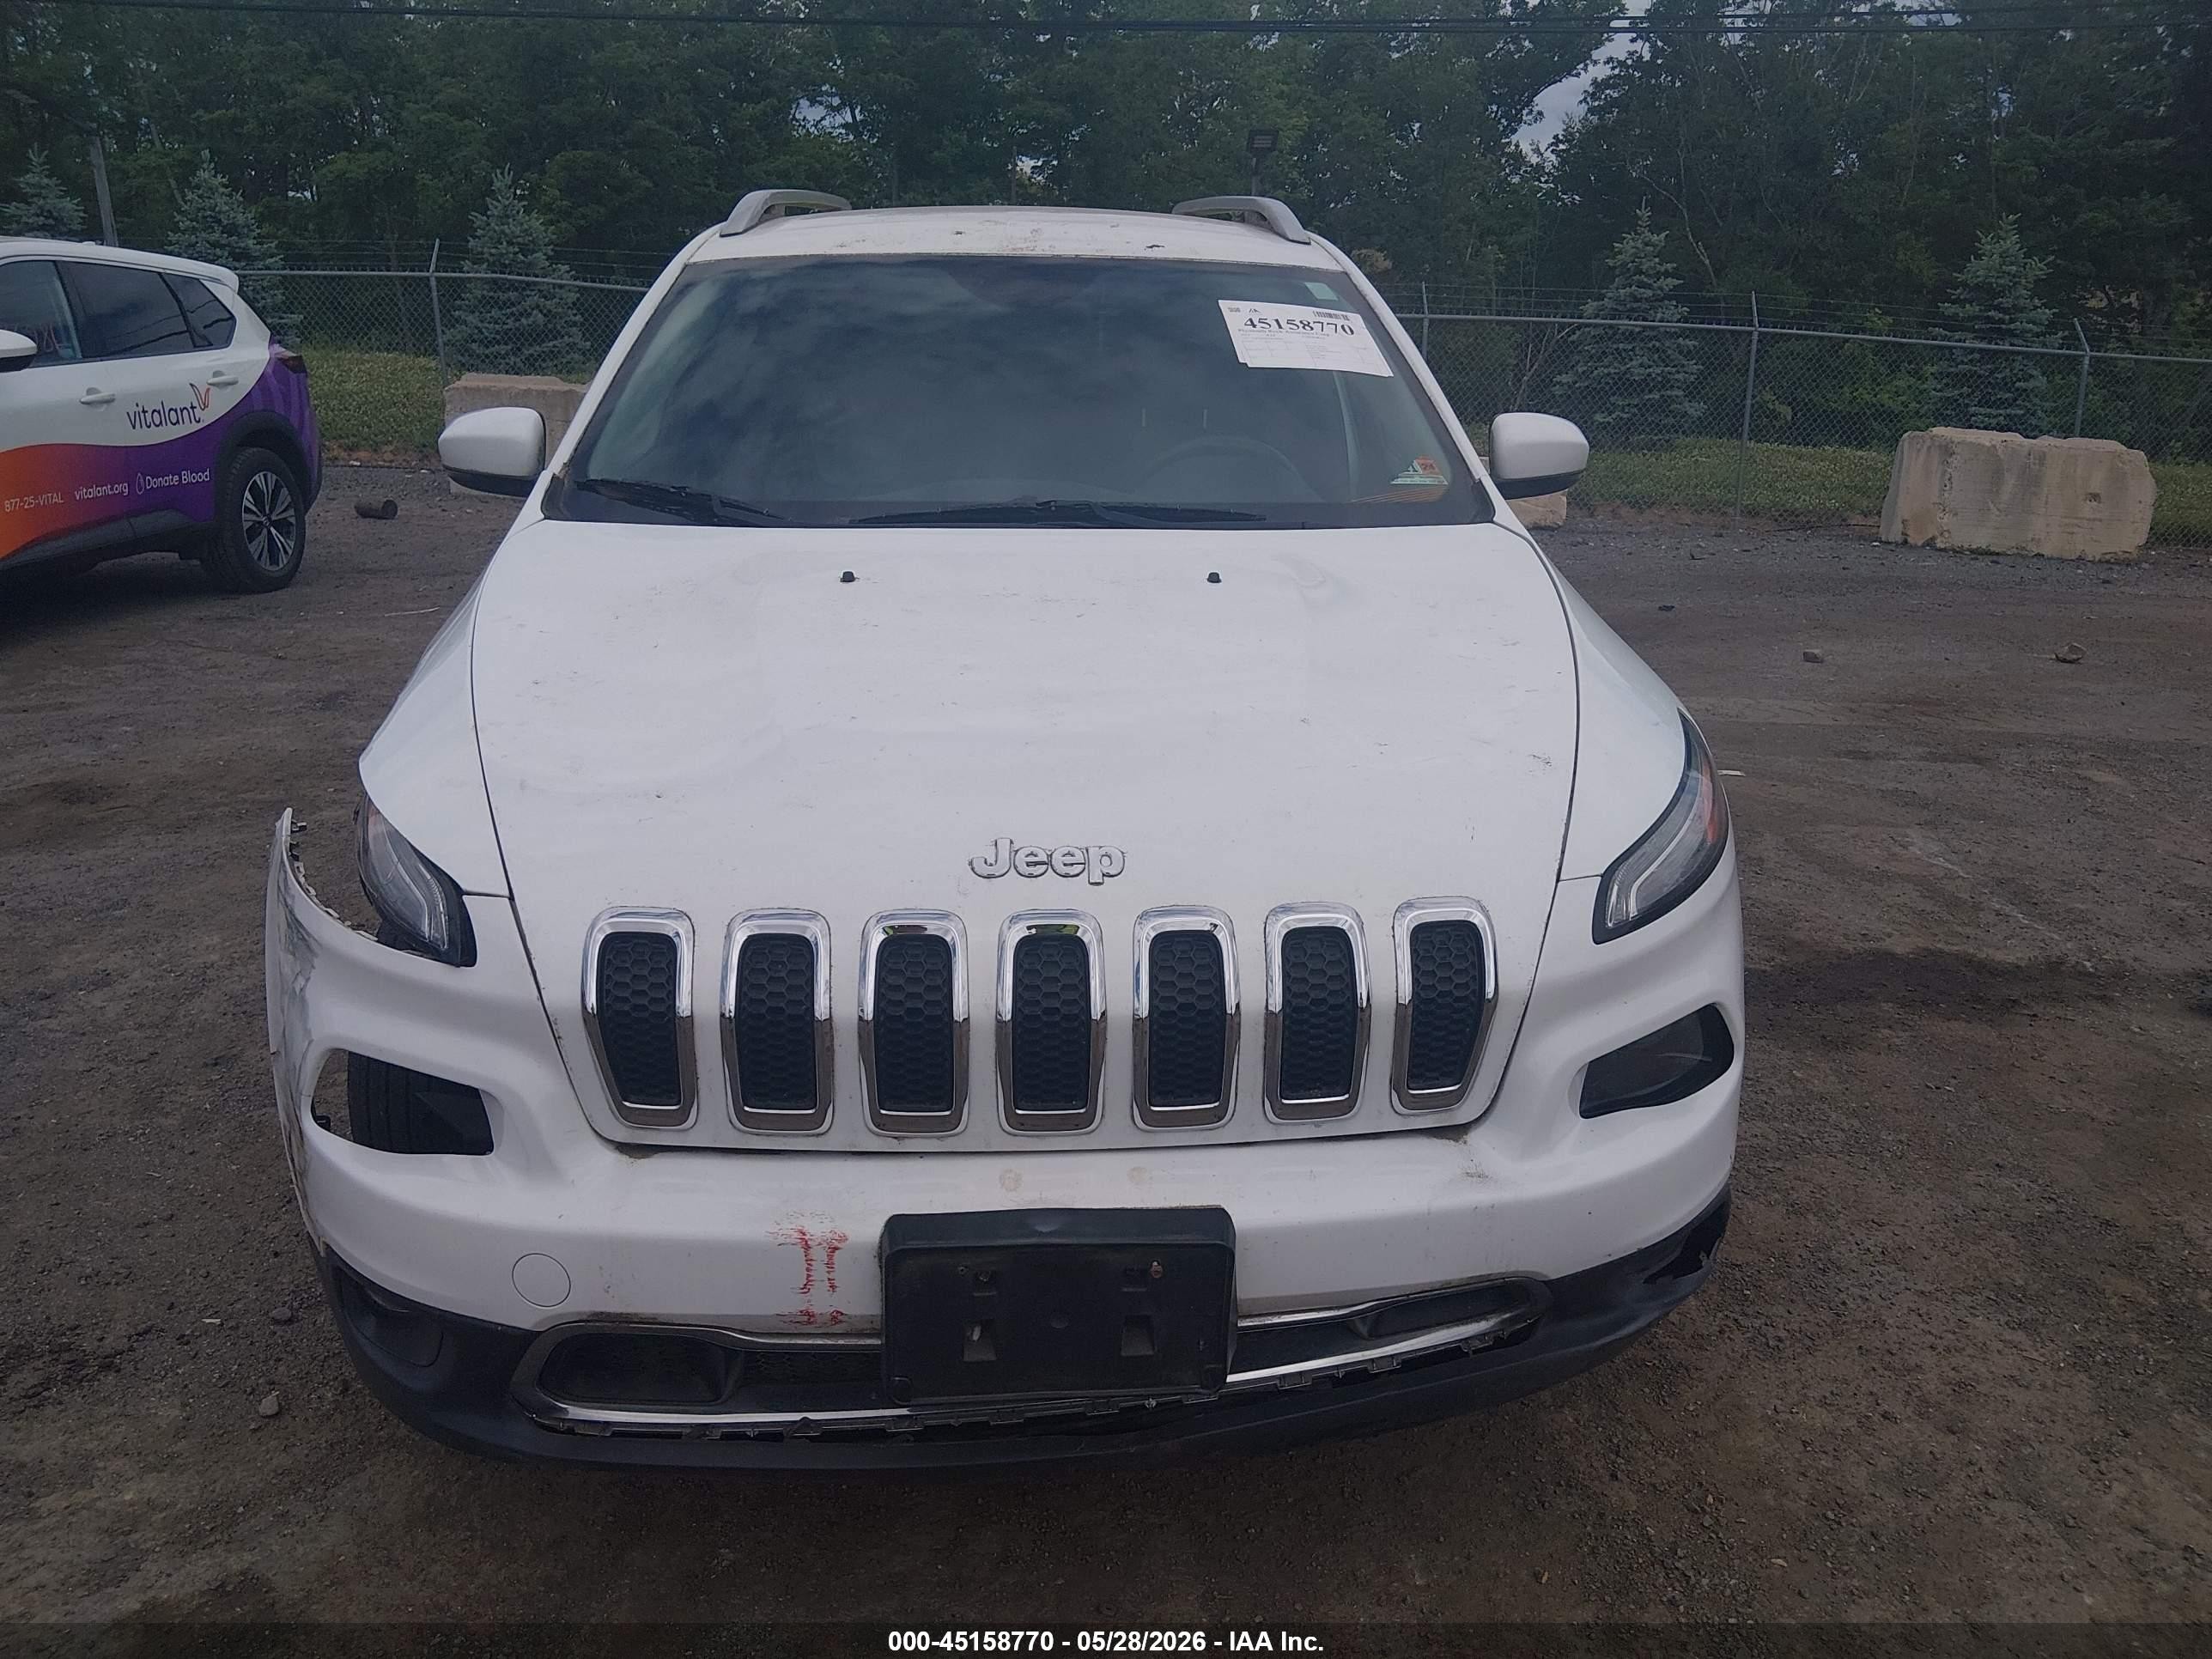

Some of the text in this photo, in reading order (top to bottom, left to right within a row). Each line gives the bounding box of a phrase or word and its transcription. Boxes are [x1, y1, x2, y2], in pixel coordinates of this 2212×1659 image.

[1244, 317, 1355, 336] 45158770
[126, 400, 201, 429] vitalant
[145, 468, 210, 489] Donate Blood
[74, 481, 129, 501] vitalant.org
[3, 492, 64, 513] 877-25-VITAL
[969, 837, 1126, 886] Jeep
